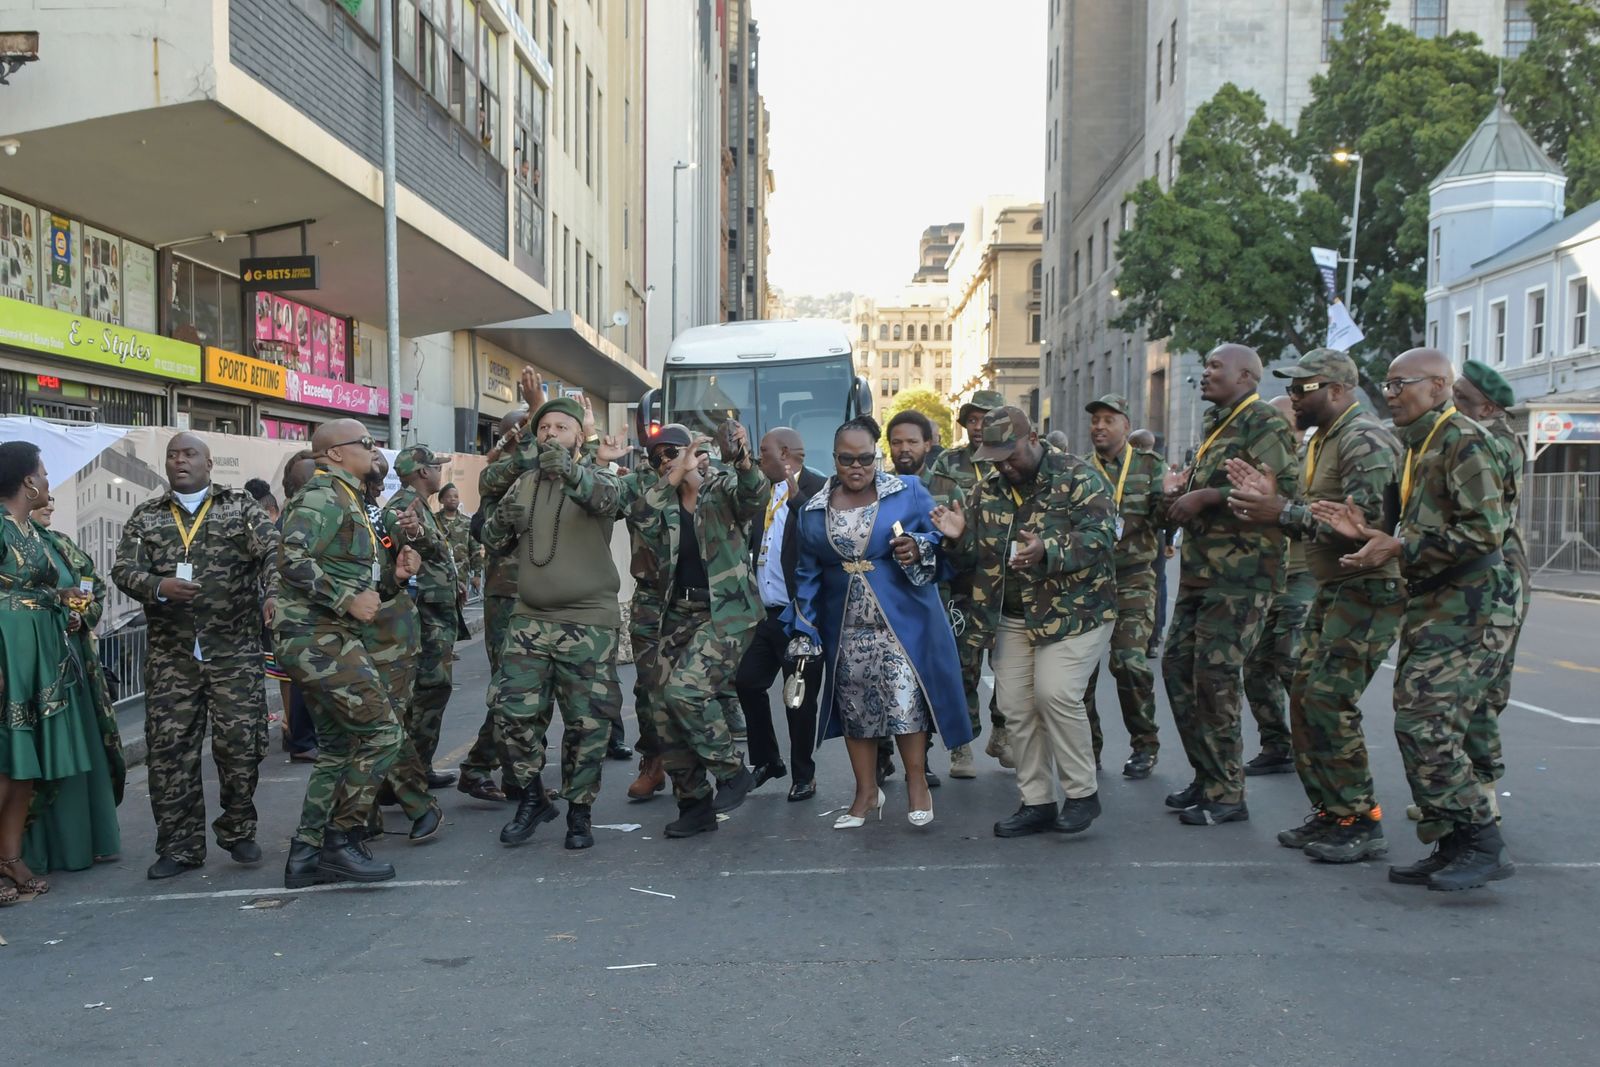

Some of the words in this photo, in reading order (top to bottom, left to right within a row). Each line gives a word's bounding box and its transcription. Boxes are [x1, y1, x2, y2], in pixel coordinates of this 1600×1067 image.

[253, 268, 291, 280] G-BETS
[68, 320, 82, 346] E
[100, 328, 151, 364] Styles
[37, 374, 60, 388] OPEN
[218, 356, 248, 383] SPORTS
[251, 365, 280, 390] BETTING
[303, 380, 333, 404] Exceeding
